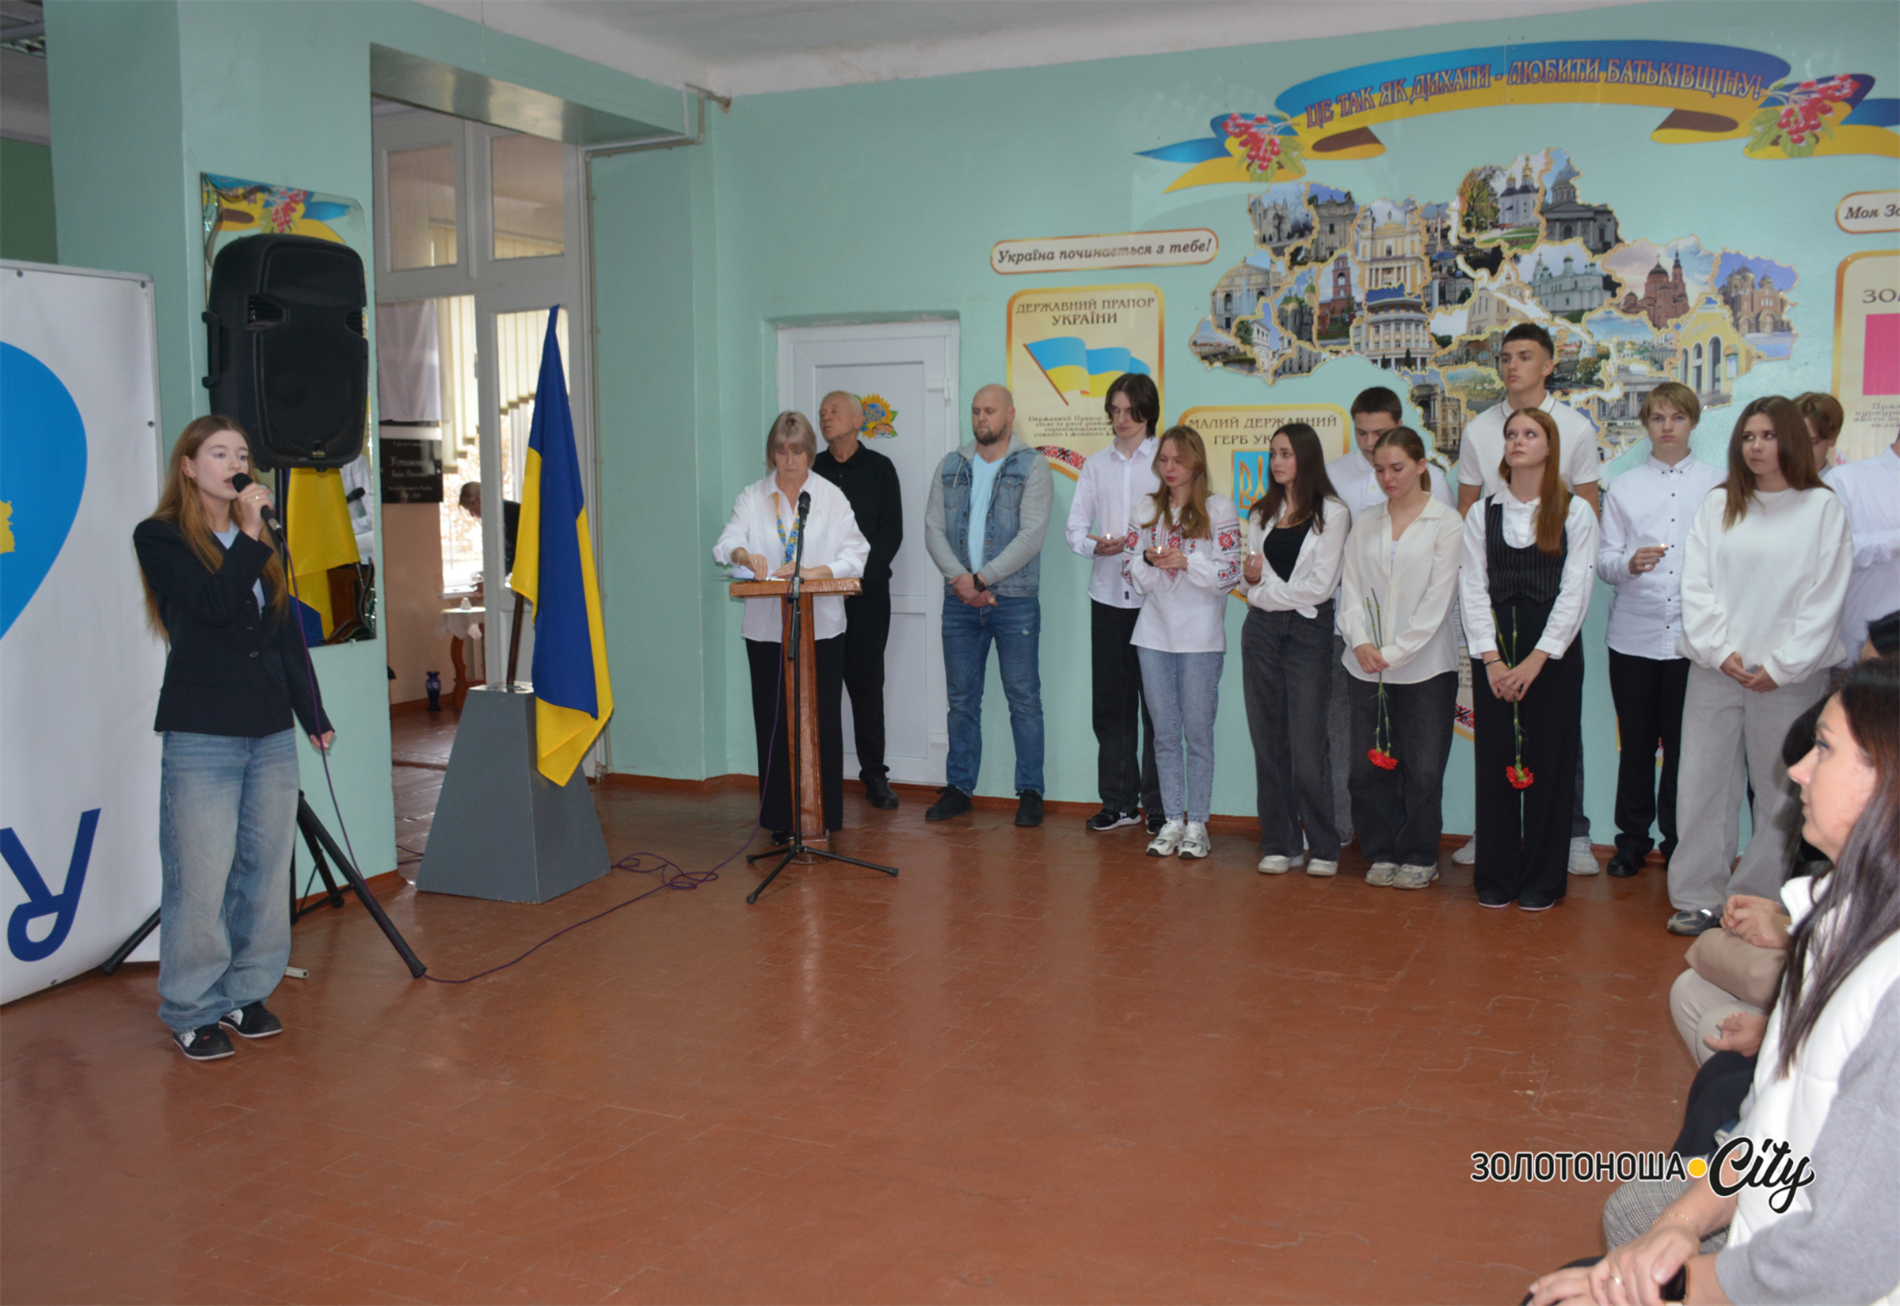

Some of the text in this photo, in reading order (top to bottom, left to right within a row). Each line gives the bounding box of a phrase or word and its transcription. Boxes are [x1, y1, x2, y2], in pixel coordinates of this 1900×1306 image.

[1305, 98, 1334, 128] ЦЕ
[1336, 86, 1376, 118] ТАК
[1379, 78, 1408, 107] ЯК
[1409, 64, 1491, 104] ДИХАТИ
[1506, 58, 1600, 86] ЛЮБИТИ
[1605, 58, 1763, 101] БАТЬКІВЩІНУ!
[1844, 206, 1879, 220] Моя
[998, 238, 1212, 265] Україна починається з тебе!
[1016, 297, 1155, 314] ДЕРЖАВНИЙ ПРАПОР
[1052, 311, 1118, 326] УКРАЇНИ
[1189, 417, 1239, 429] МАЛИЙ
[1214, 434, 1248, 446] ГЕРБ
